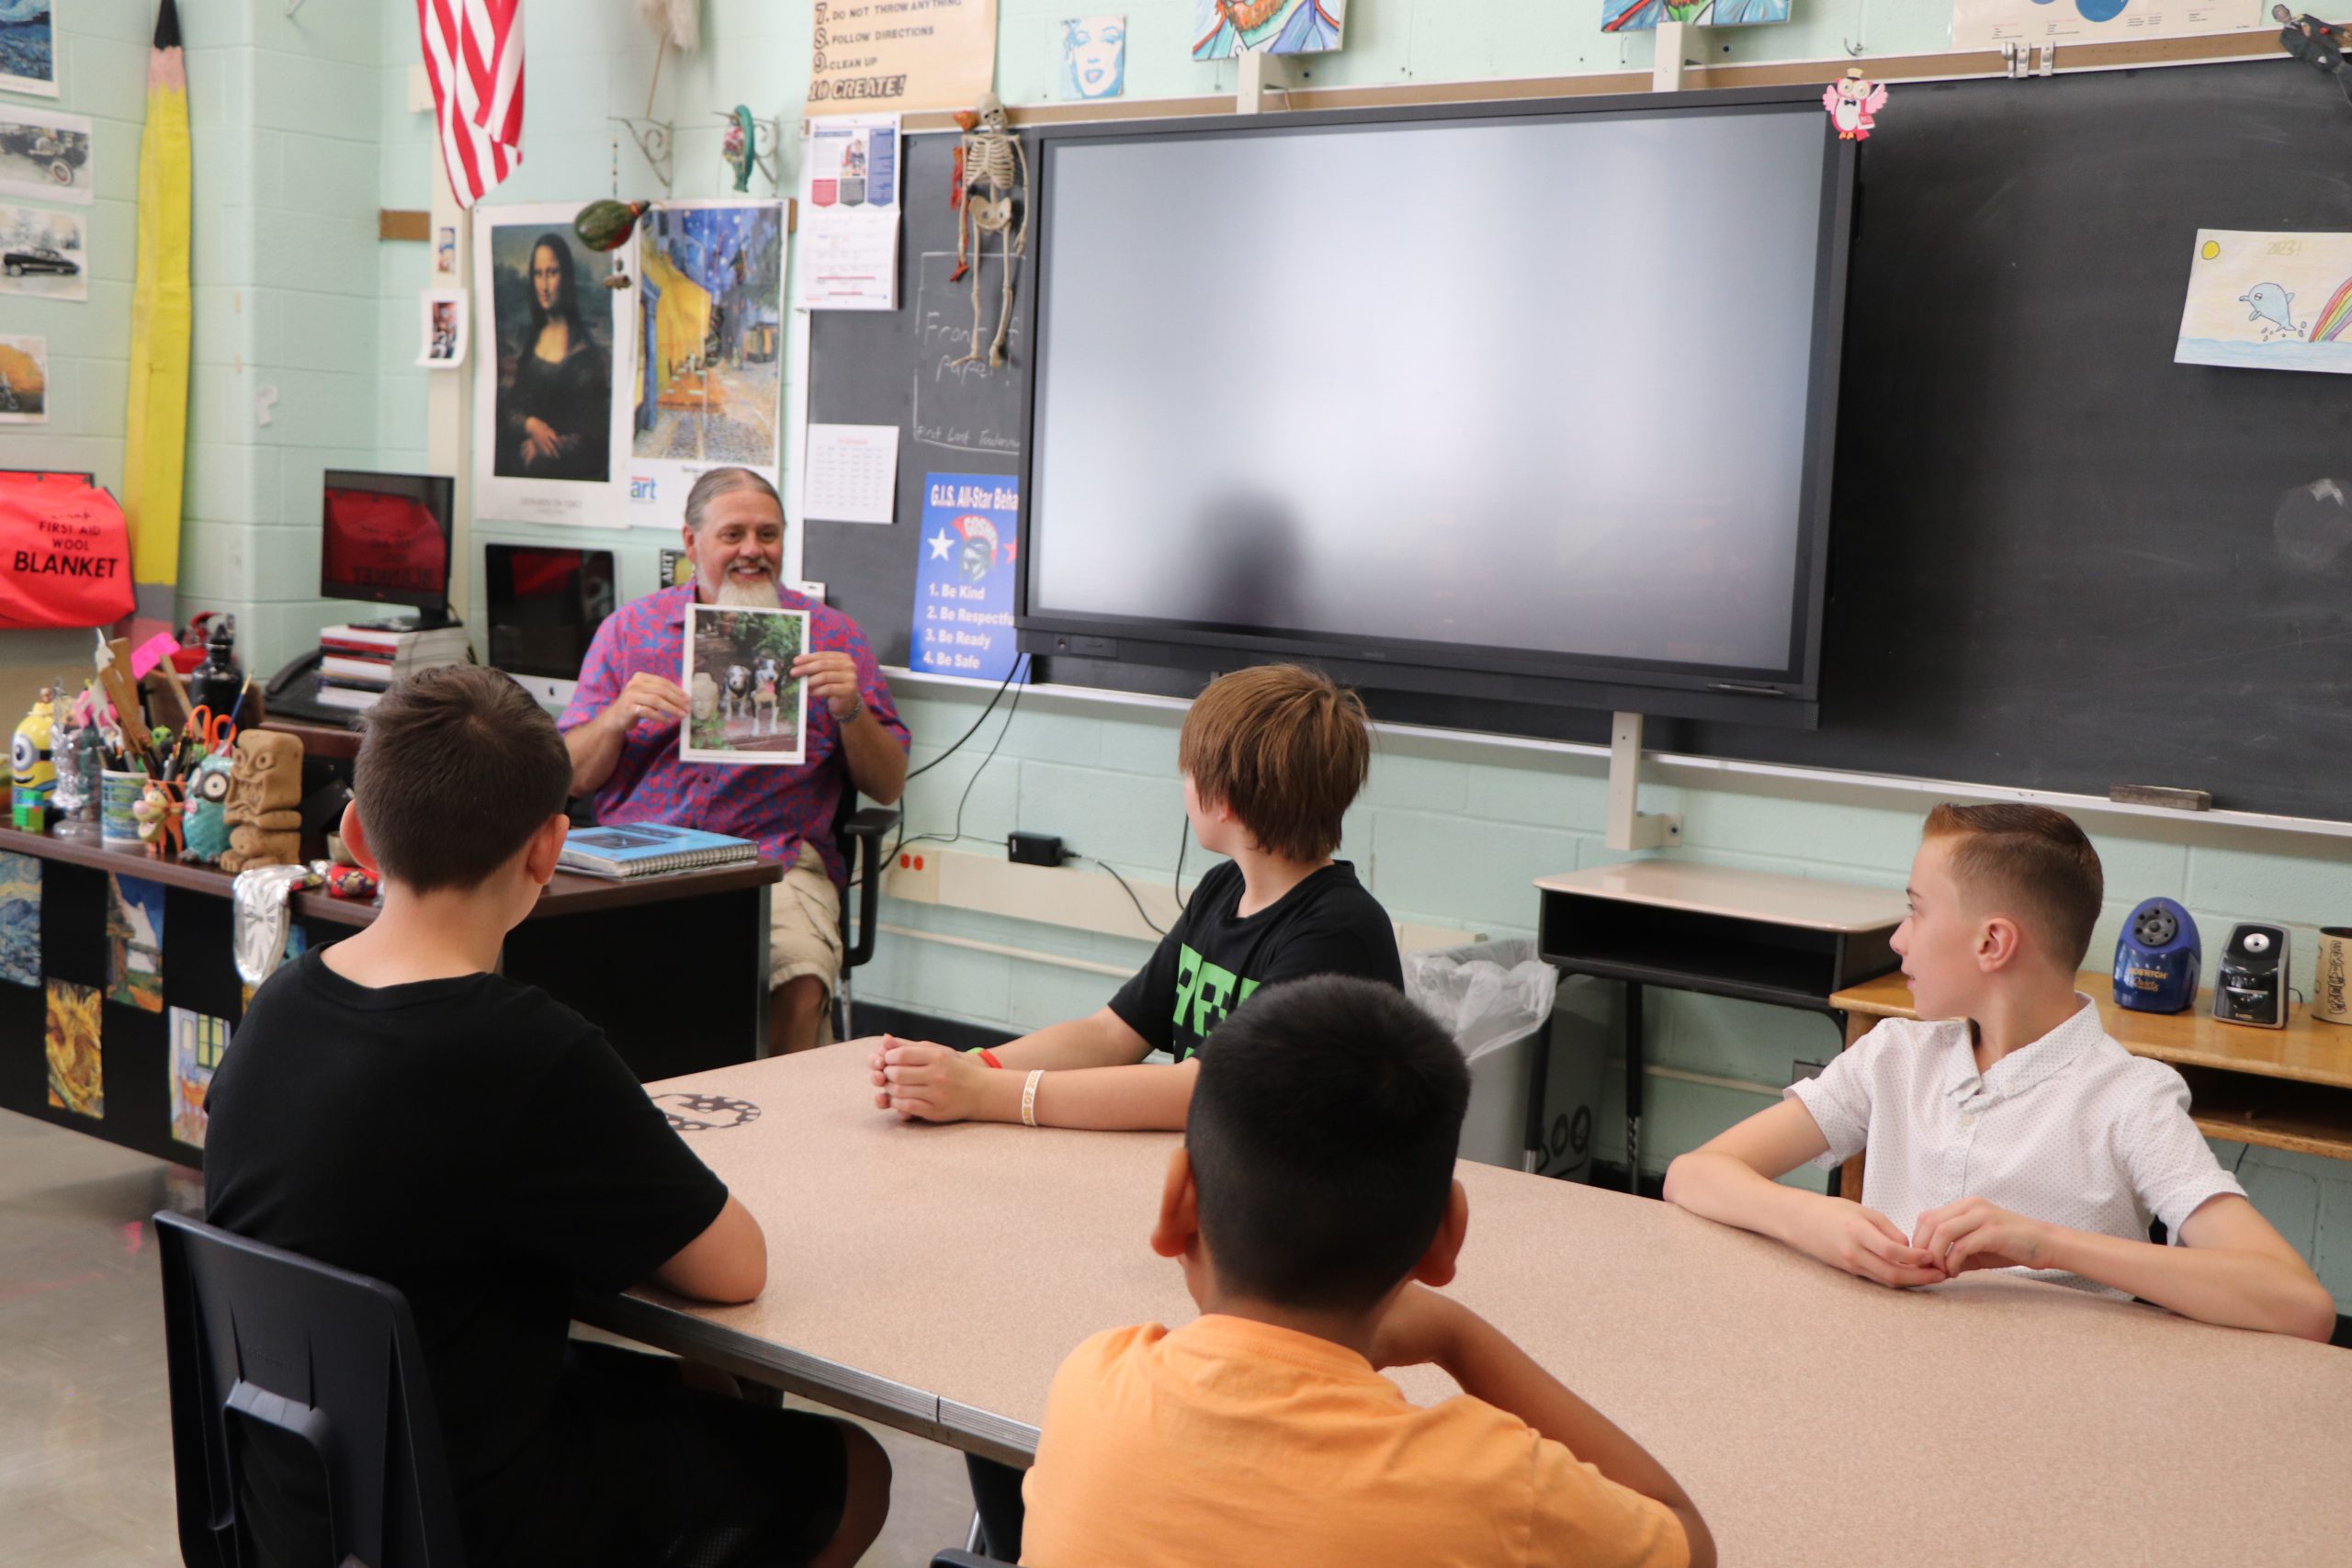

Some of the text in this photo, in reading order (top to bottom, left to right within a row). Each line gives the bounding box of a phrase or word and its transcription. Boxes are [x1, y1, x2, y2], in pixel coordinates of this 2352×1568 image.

[832, 10, 846, 20] DO
[850, 6, 869, 17] NOT
[874, 3, 908, 15] THROW
[832, 32, 870, 44] FOLLOW
[874, 26, 934, 40] DIRECTIONS
[830, 58, 862, 70] CLEAN
[864, 57, 878, 67] UP
[831, 74, 907, 100] CREATE!
[631, 478, 656, 500] art
[931, 484, 956, 508] G.I.S.
[956, 485, 993, 509] All-Star
[39, 521, 100, 536] FIRST AID
[52, 538, 89, 551] WOOL
[14, 550, 119, 579] BLANKET
[941, 583, 956, 598] Be
[959, 585, 985, 600] Kind
[926, 605, 937, 620] 2.
[940, 606, 956, 621] Be
[925, 628, 991, 650] 3. Be Ready
[923, 651, 980, 670] 4. Be Safe
